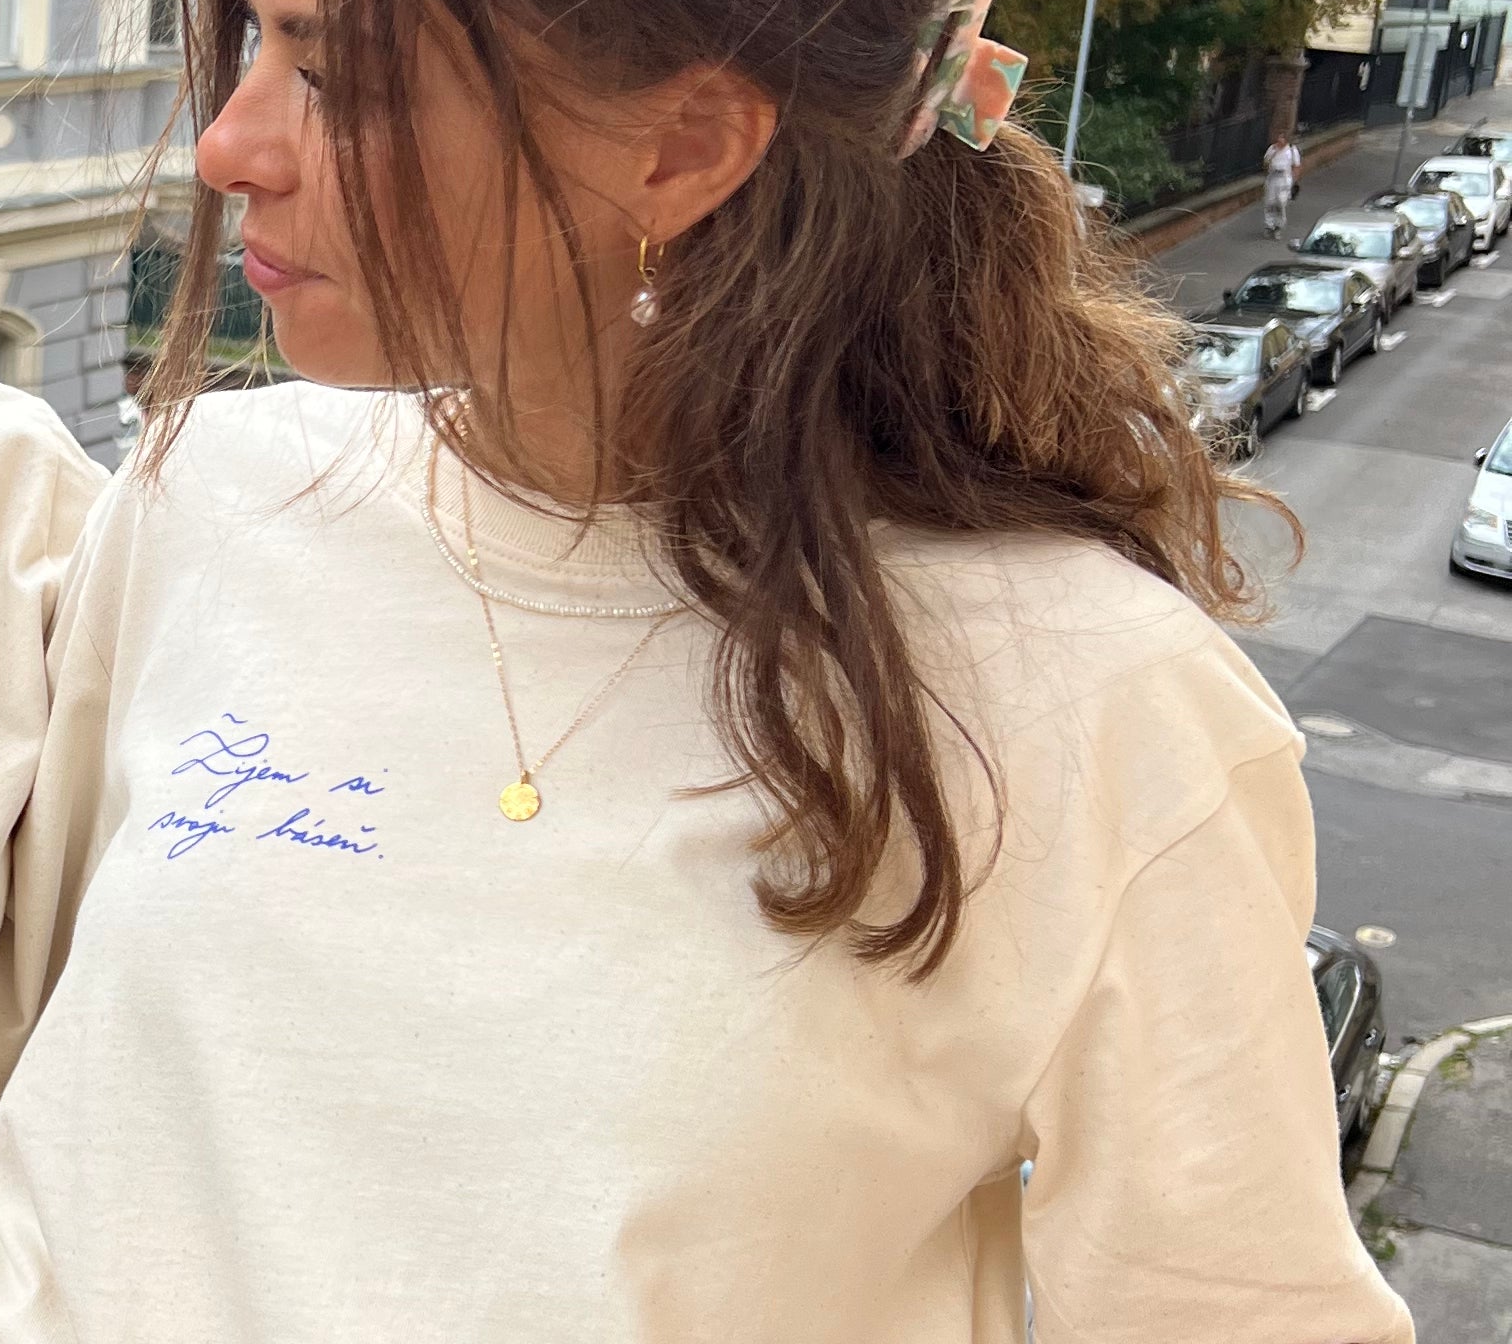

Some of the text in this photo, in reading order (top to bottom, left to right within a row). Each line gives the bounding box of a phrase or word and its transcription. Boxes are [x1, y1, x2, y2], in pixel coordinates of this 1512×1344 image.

[171, 713, 388, 810] Žijem si
[147, 807, 384, 860] svoju báseň.
